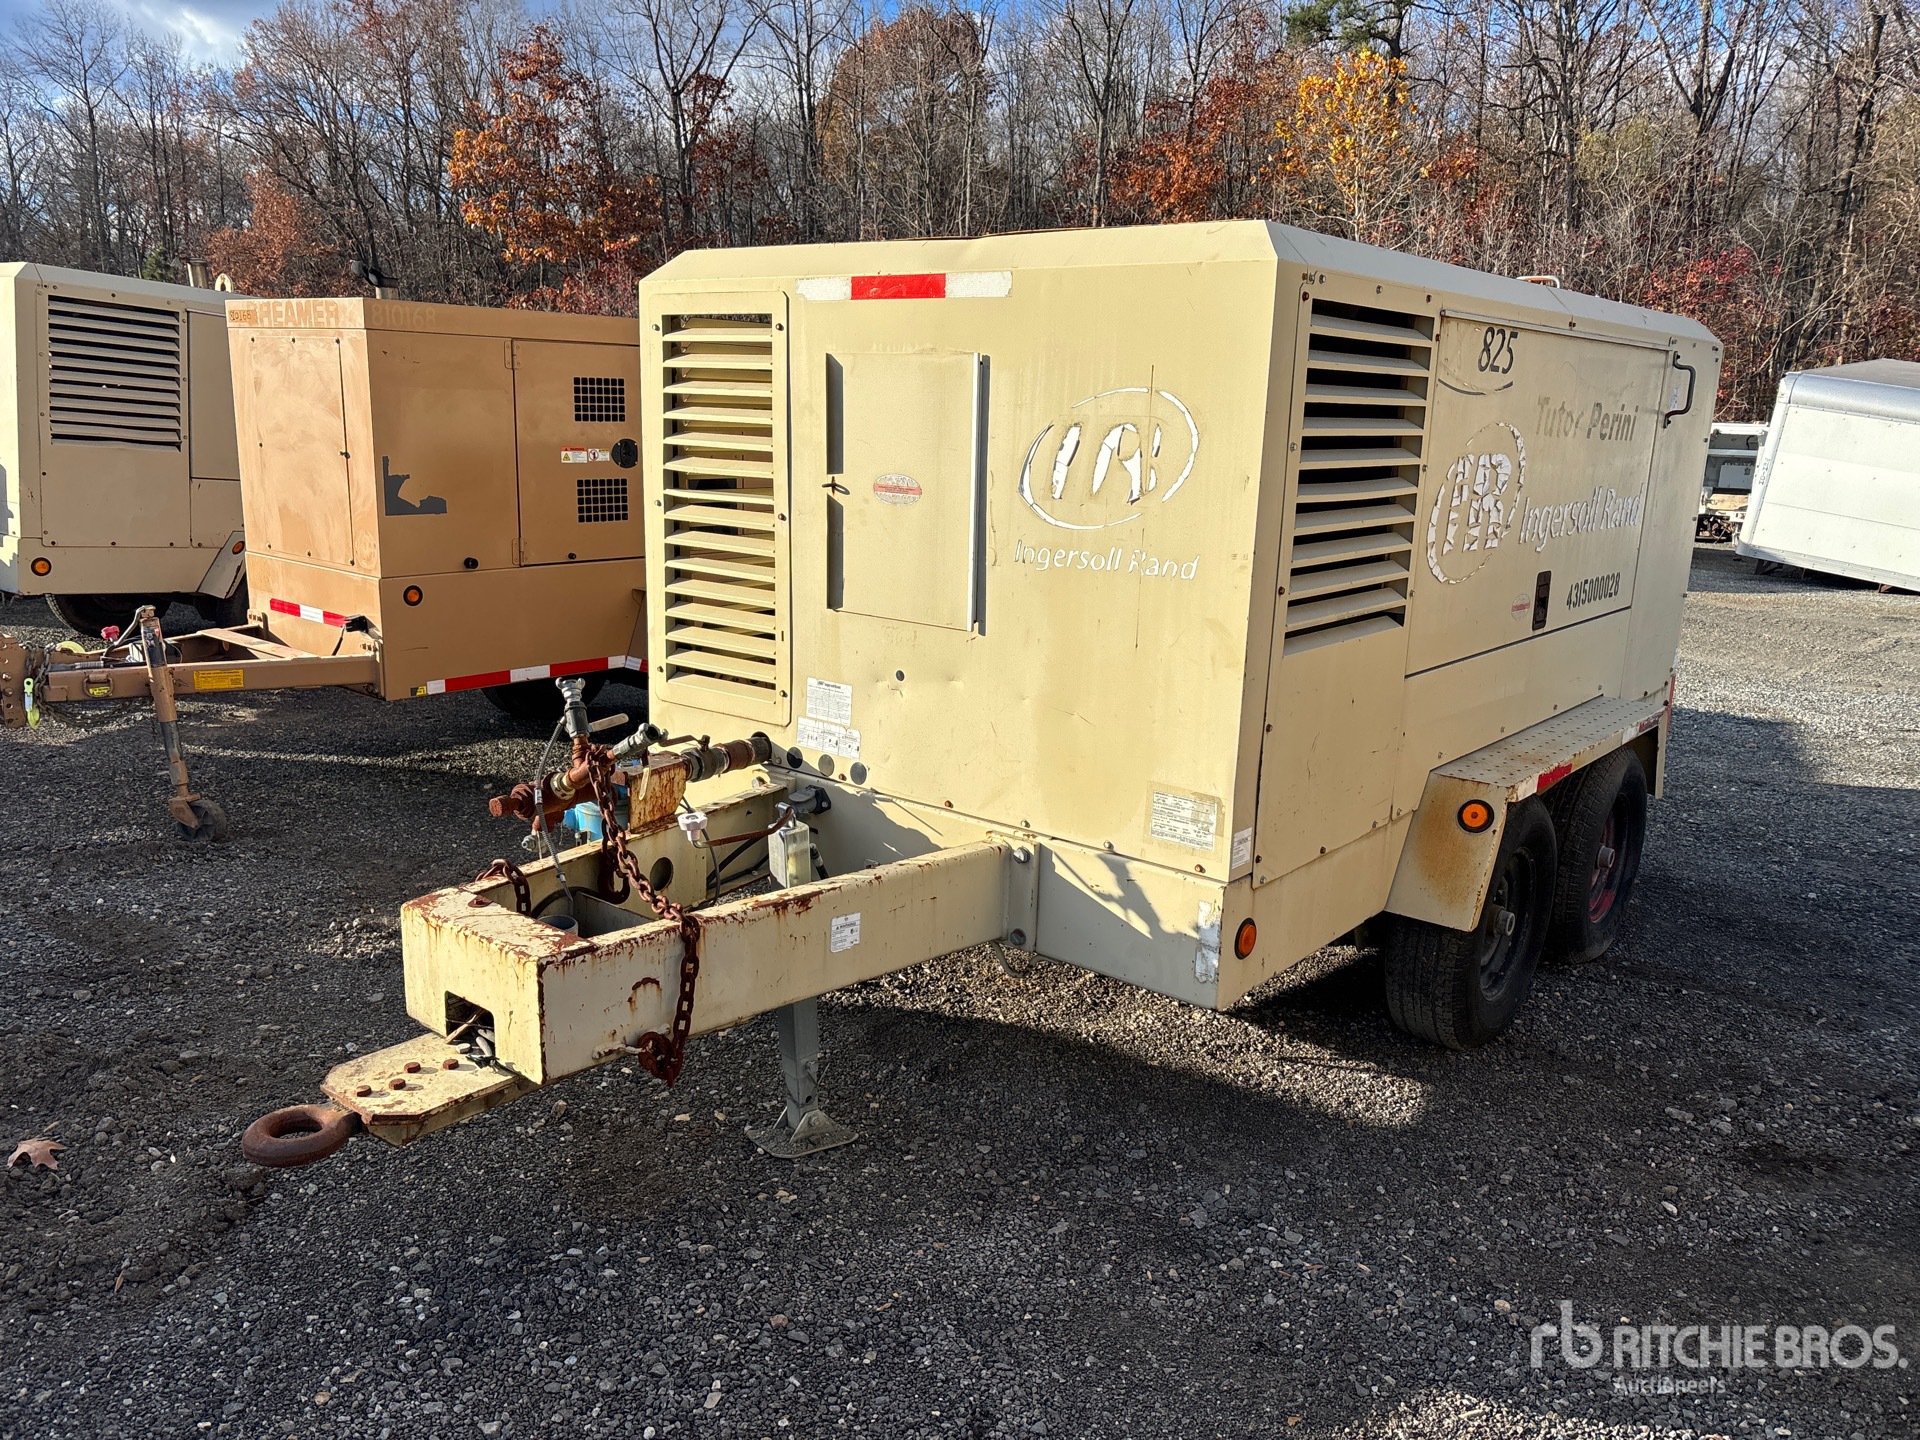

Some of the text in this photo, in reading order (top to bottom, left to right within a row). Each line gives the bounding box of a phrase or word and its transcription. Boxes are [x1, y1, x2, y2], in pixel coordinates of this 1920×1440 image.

[1477, 326, 1519, 375] 825
[1535, 394, 1639, 442] Tutor Perini
[1518, 483, 1645, 553] Ingersoll Rand
[1014, 539, 1200, 580] Ingersoll Rand
[1566, 571, 1621, 611] 4315000028
